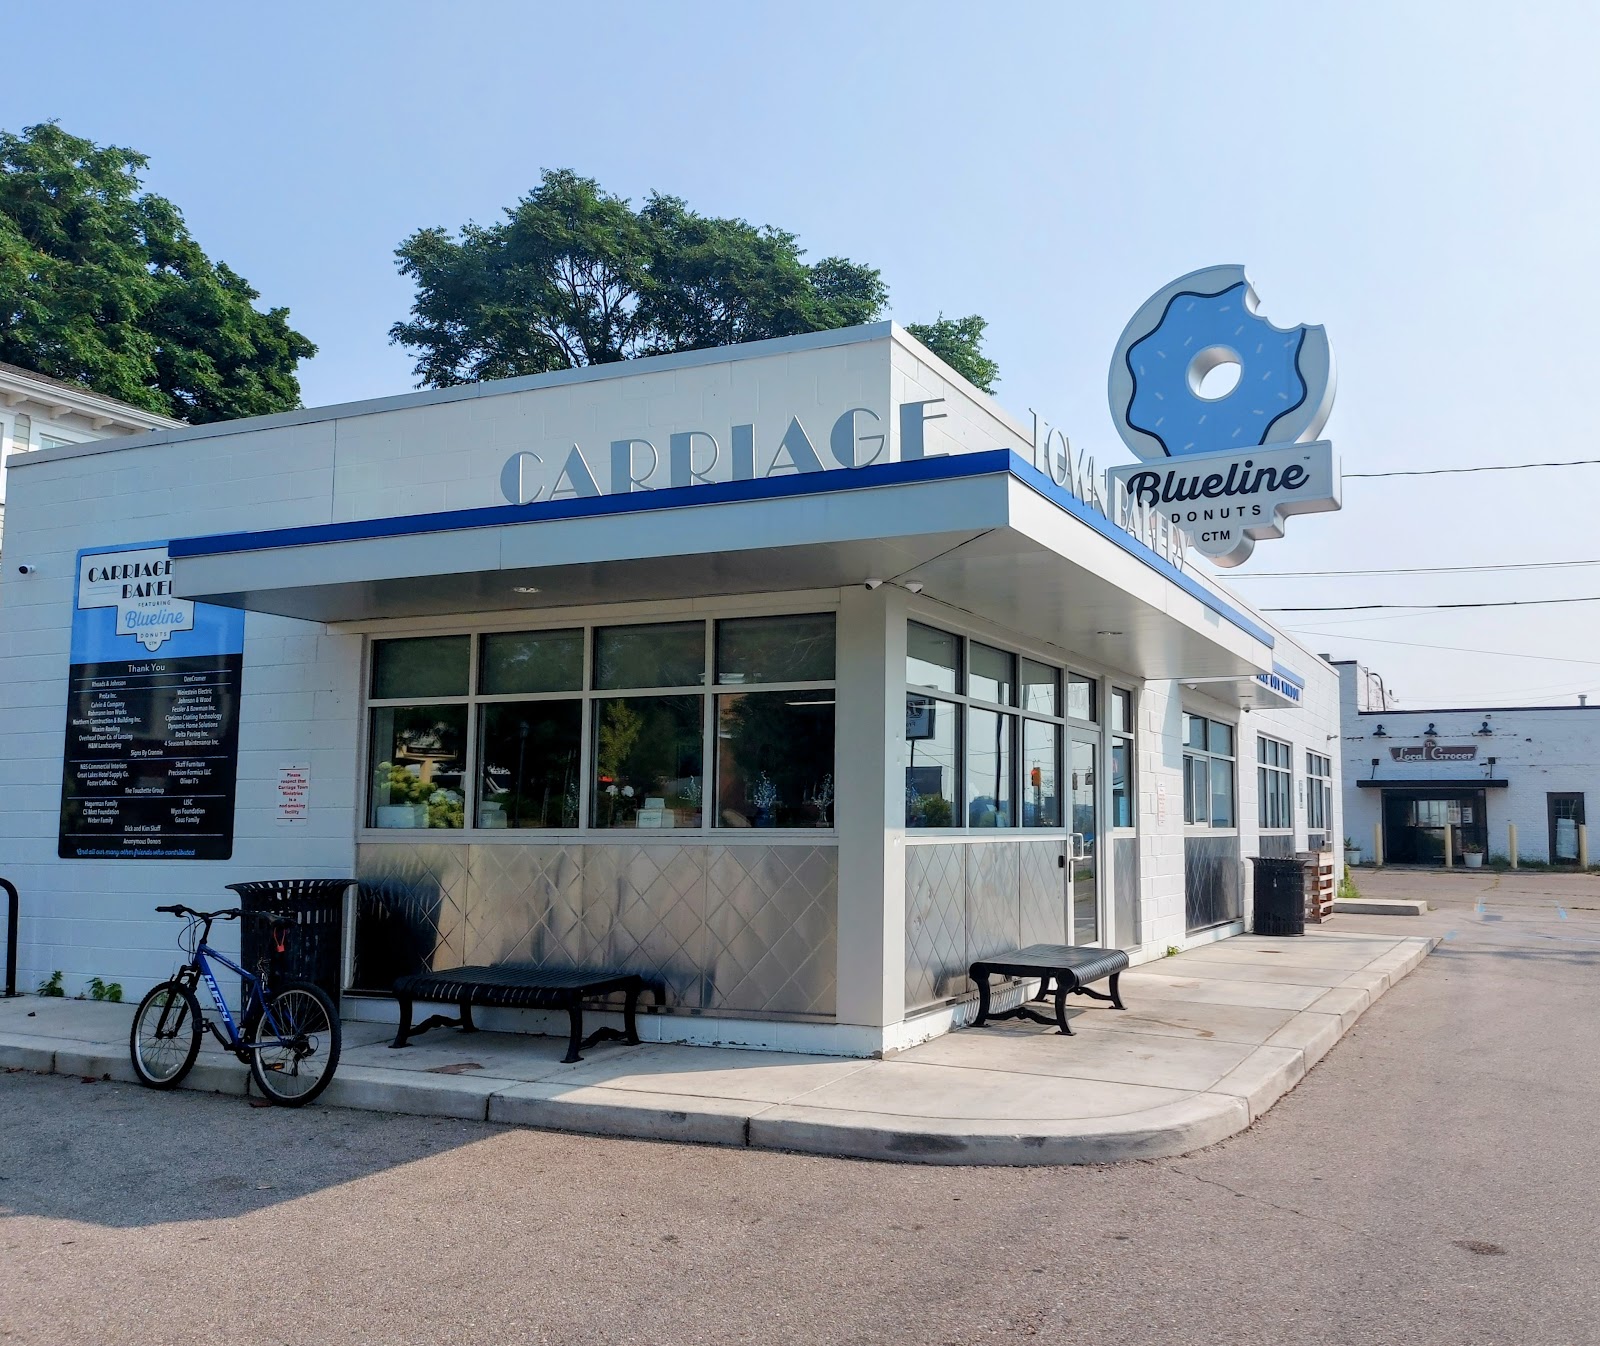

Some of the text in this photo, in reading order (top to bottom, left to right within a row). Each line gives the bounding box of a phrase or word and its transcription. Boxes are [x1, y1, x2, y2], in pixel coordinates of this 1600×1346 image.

[500, 397, 949, 506] CARRIAGE
[1127, 460, 1310, 508] Blueline
[1171, 503, 1262, 524] DONUTS
[1201, 530, 1231, 542] CTM
[88, 560, 173, 582] CARRIAGE
[124, 609, 184, 628] Blueline
[128, 662, 165, 672] Thank You
[1396, 746, 1474, 763] Local Grocer
[100, 817, 114, 825] Family
[186, 816, 200, 824] Family
